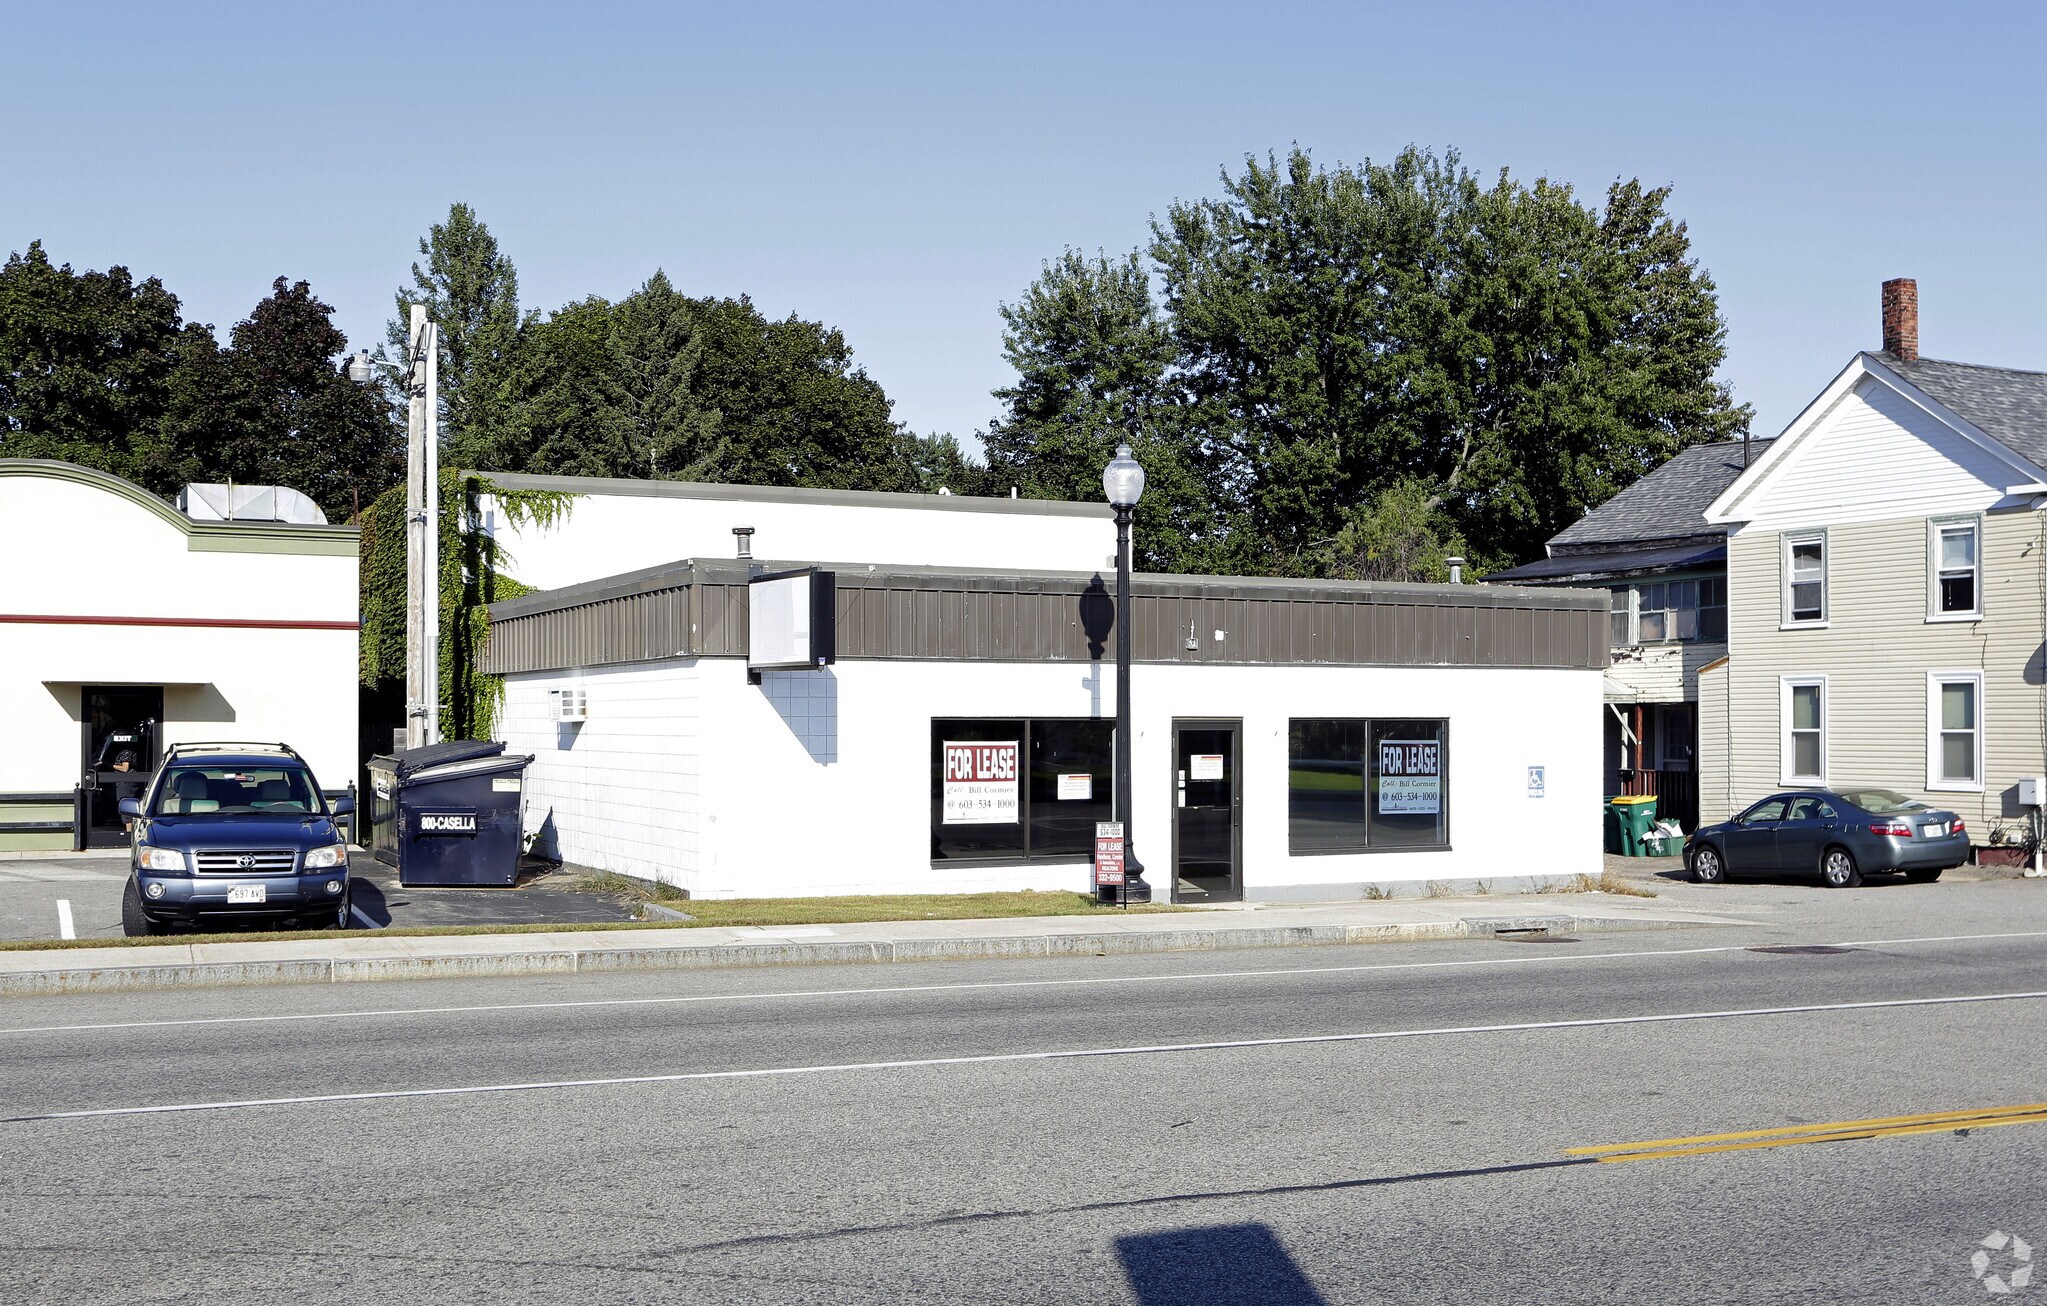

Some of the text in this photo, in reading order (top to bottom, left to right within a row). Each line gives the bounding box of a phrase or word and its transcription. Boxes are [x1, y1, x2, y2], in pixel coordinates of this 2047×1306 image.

[948, 749, 1014, 779] FOR LEASE
[1383, 747, 1436, 774] FOR LEASE
[1391, 792, 1437, 801] 603-534-1000
[948, 799, 1015, 809] @ 603-534-1000
[421, 817, 475, 829] 800-CASELLA
[1098, 843, 1123, 851] FOR LEASE
[1098, 873, 1122, 882] 332-9500
